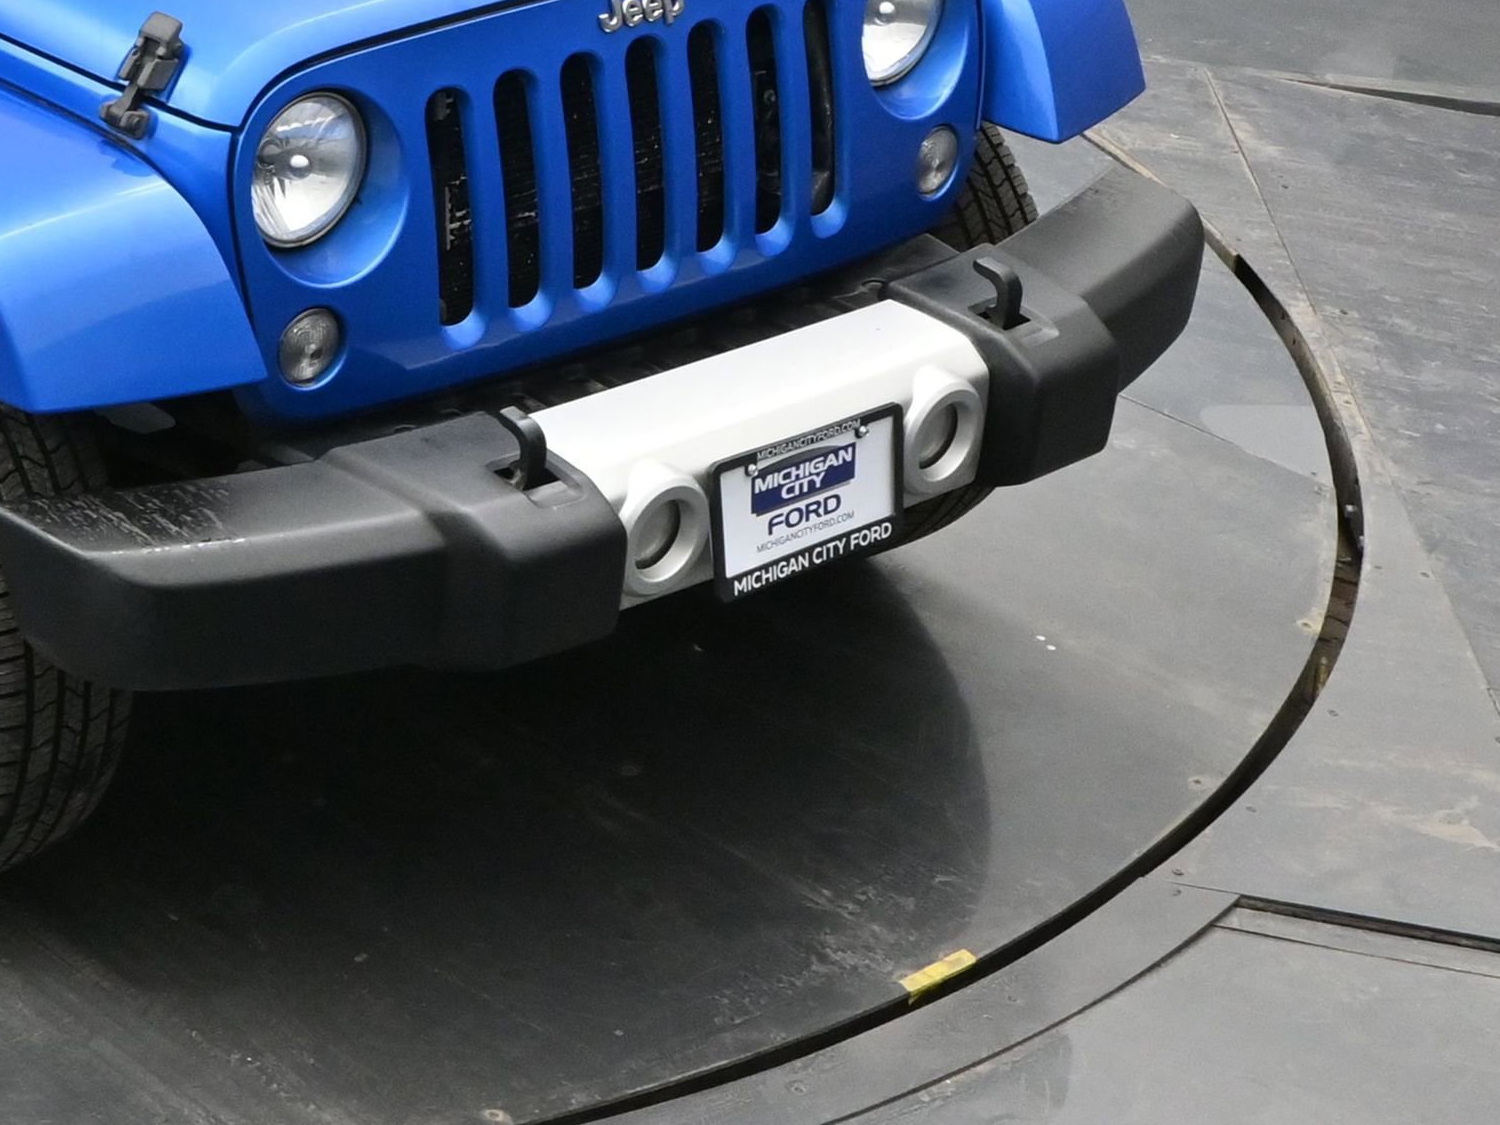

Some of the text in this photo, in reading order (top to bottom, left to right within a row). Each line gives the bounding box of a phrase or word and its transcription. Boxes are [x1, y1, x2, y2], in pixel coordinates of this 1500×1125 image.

[757, 418, 861, 460] MICHIGANCITYFORD.COM
[754, 446, 853, 494] MICHIGAN
[781, 472, 825, 499] CITY
[757, 510, 855, 553] MICHIGANCITYFORD.COM
[768, 493, 841, 535] FORD
[734, 522, 892, 596] MICHIGAN CITY FORD
